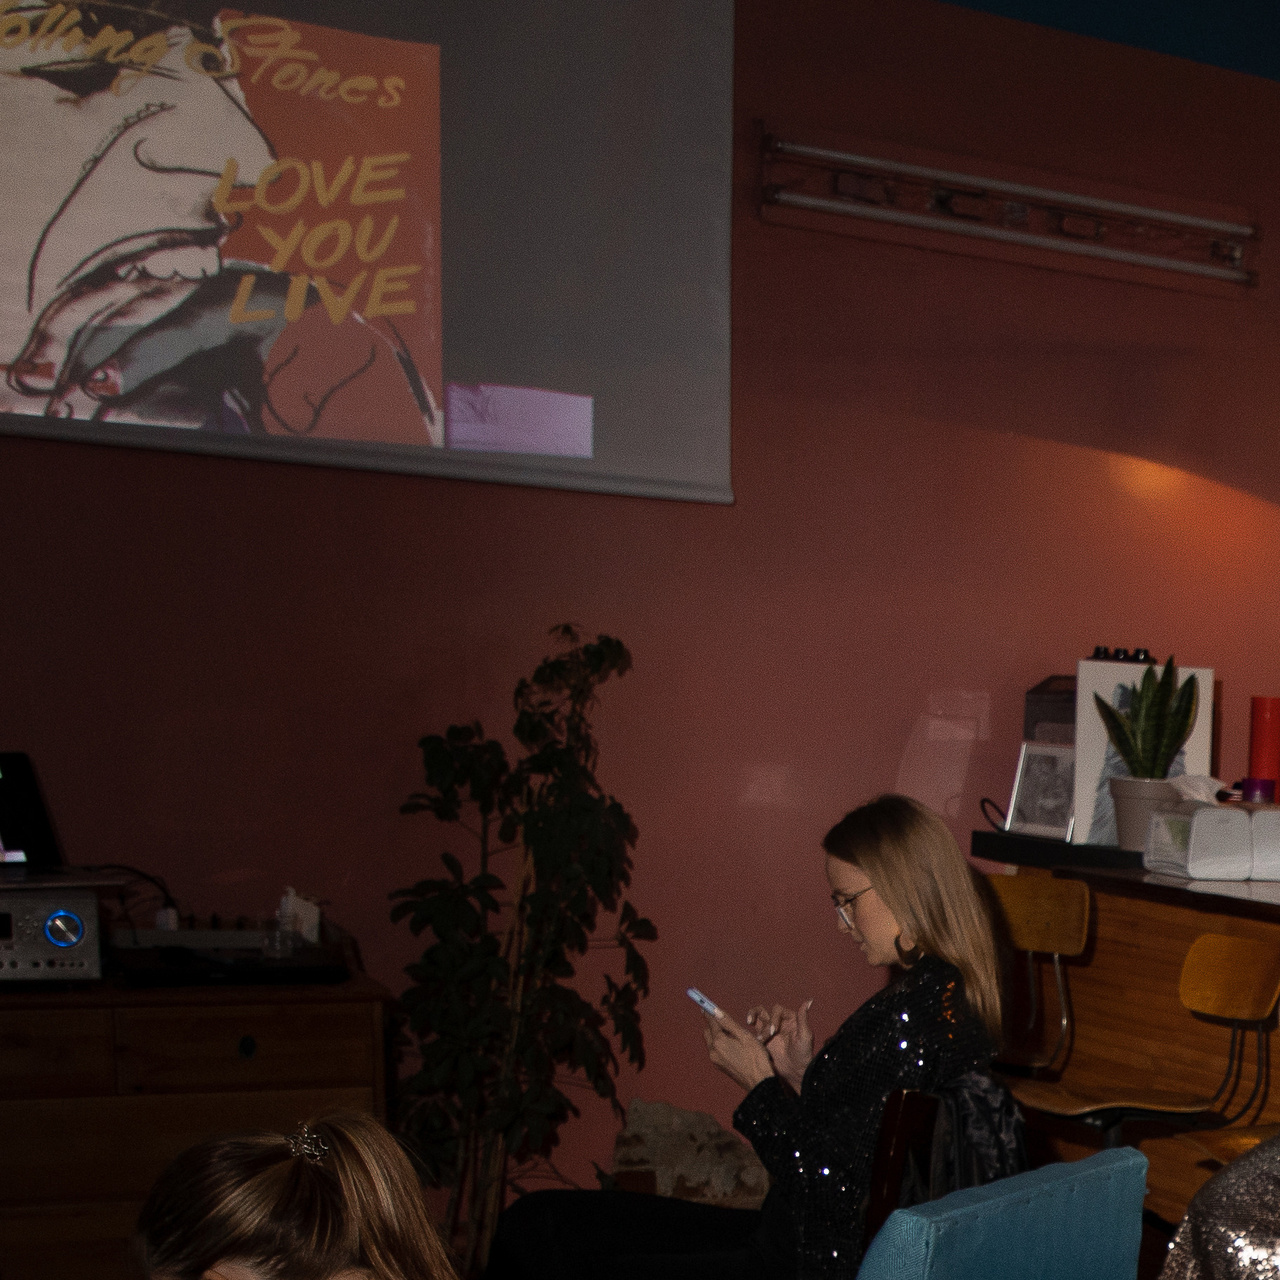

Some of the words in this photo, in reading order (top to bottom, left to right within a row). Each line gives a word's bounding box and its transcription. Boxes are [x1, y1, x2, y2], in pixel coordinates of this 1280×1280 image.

[212, 152, 411, 214] LOVE
[256, 214, 399, 272] YOU
[229, 264, 422, 325] LIVE
